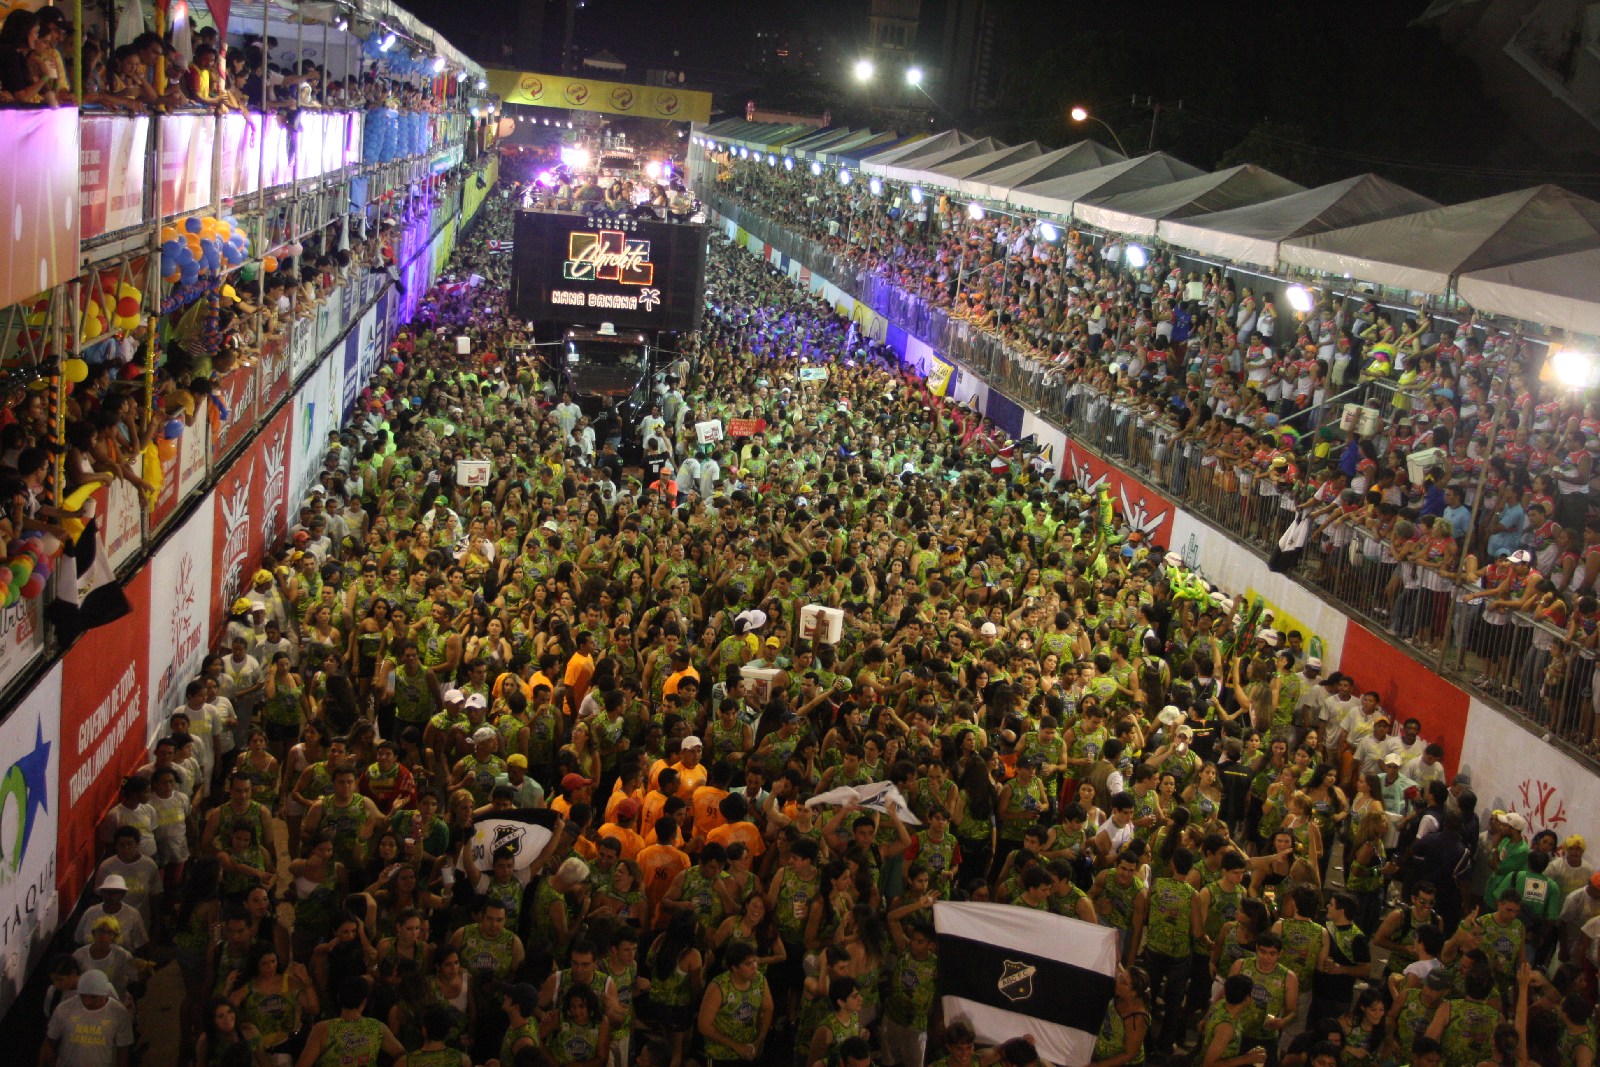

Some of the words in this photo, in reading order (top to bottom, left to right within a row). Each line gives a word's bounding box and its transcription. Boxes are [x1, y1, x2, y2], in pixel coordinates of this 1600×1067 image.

[552, 290, 585, 306] NANA
[588, 293, 637, 310] BANANA
[78, 695, 111, 755] GOVERNO
[111, 683, 120, 719] DE
[120, 659, 136, 704] TODOS
[706, 806, 718, 819] 93
[655, 867, 667, 880] 86
